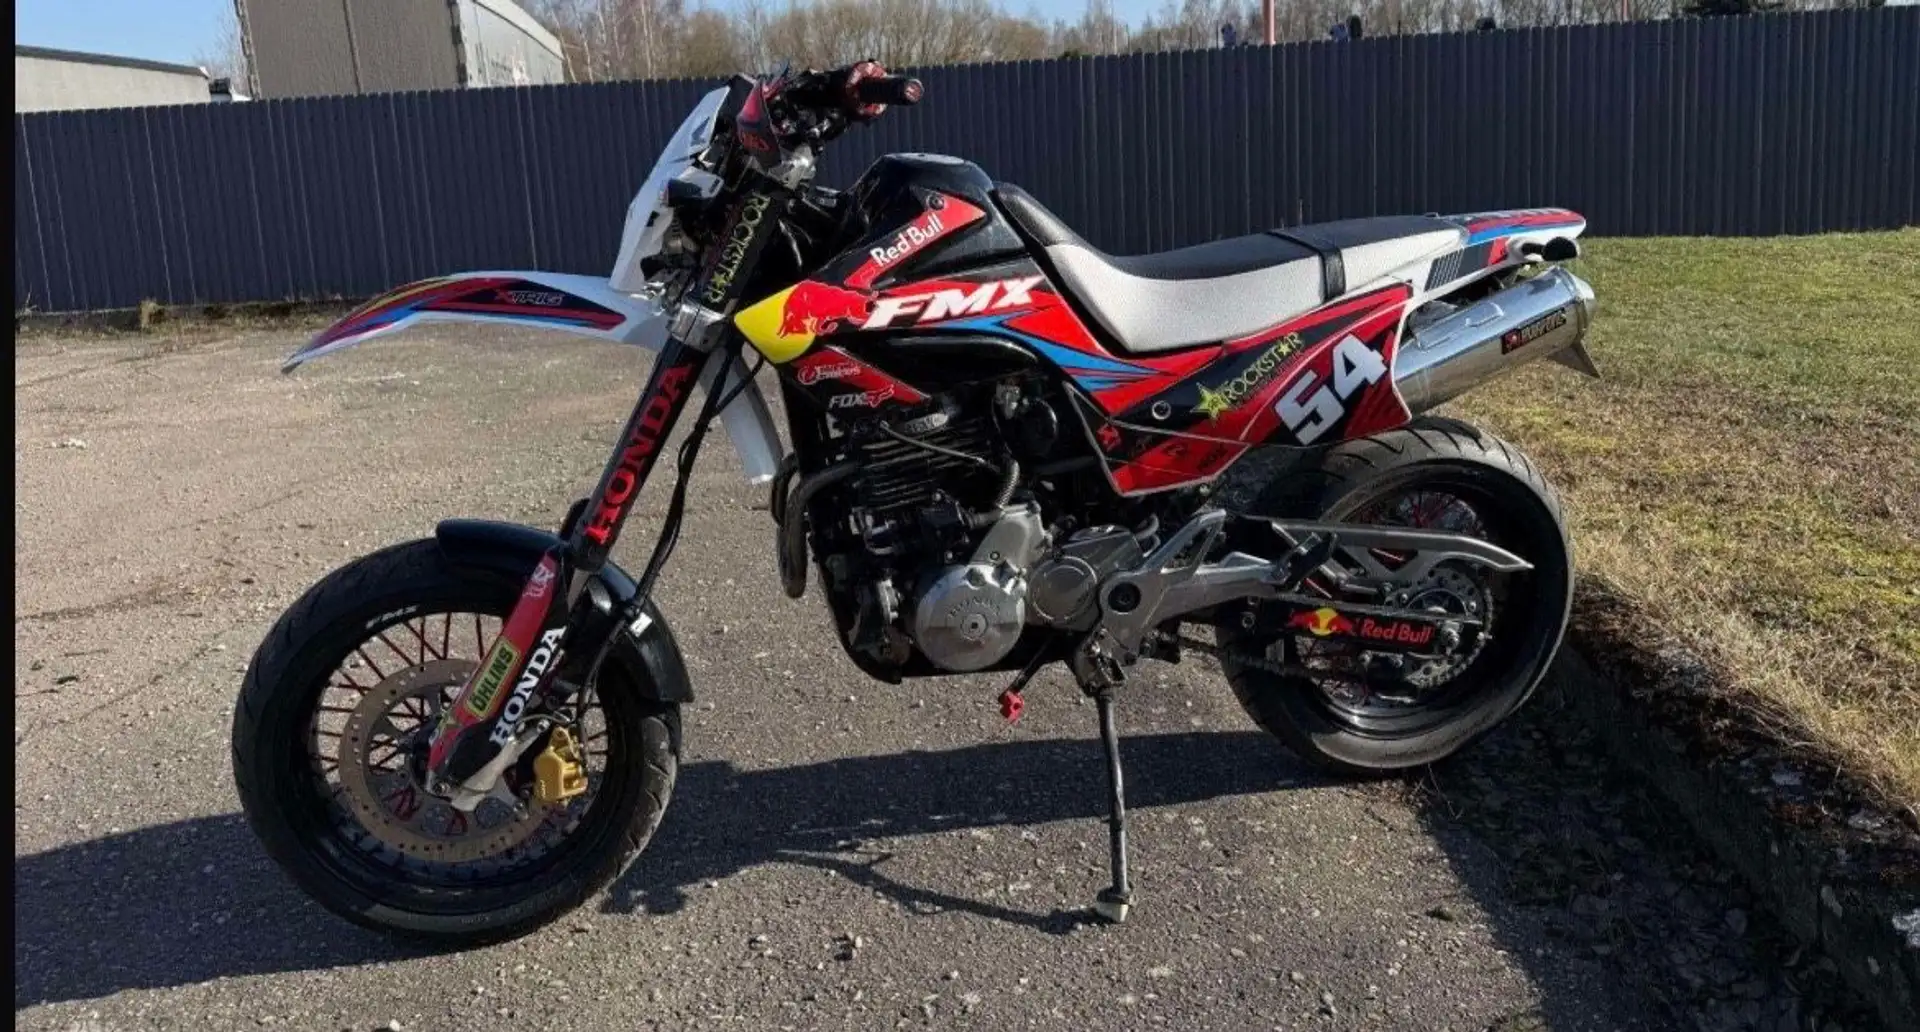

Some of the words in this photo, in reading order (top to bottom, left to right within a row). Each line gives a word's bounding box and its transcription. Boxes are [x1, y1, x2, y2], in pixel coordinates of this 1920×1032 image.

[870, 234, 911, 267] Red
[906, 213, 944, 245] Bull
[860, 275, 1046, 331] FMX
[829, 393, 868, 409] FOX
[1274, 332, 1388, 446] 54
[584, 362, 695, 544] HONDA
[1360, 617, 1396, 639] Red
[1397, 623, 1434, 644] Bull
[488, 625, 568, 746] HONDA
